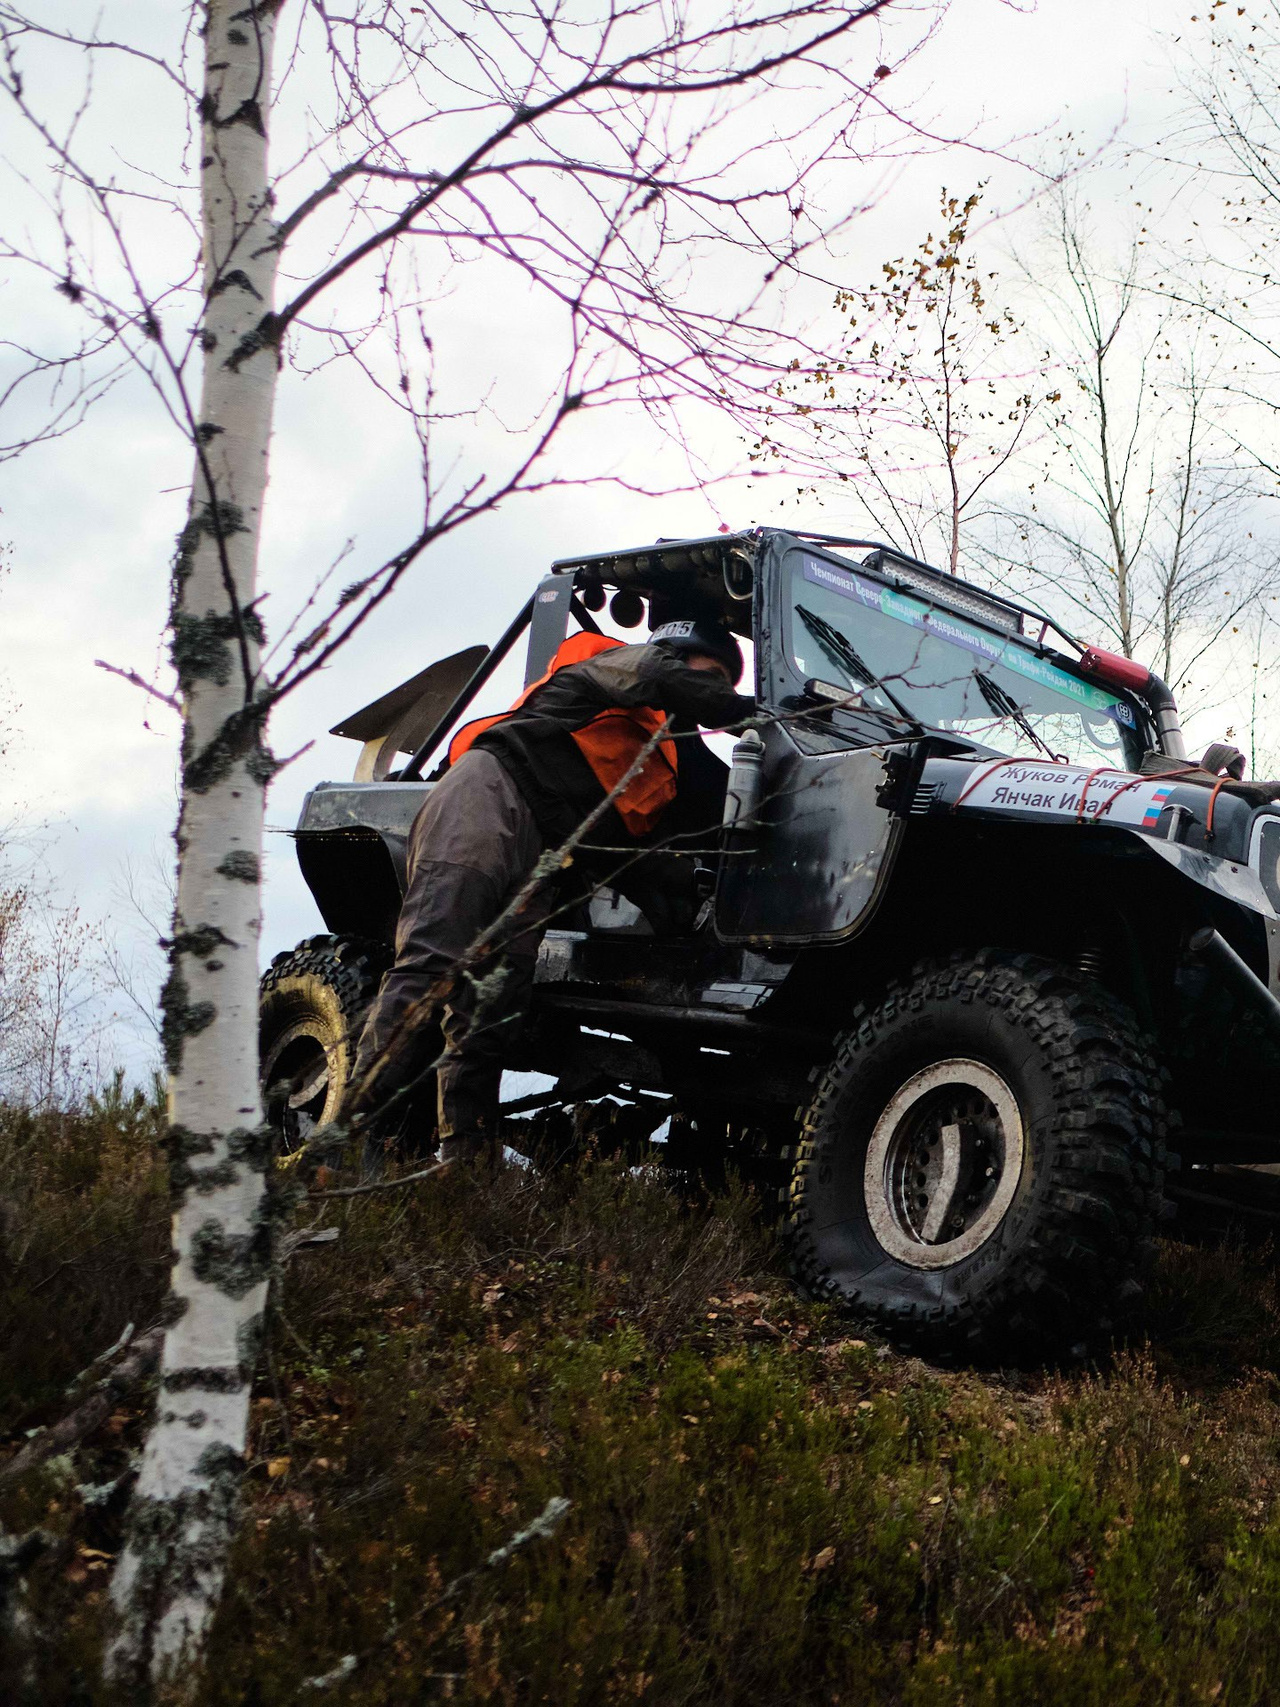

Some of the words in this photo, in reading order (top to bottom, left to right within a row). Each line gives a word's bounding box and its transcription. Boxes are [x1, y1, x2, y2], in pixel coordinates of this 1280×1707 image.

[655, 622, 691, 638] 205
[810, 561, 854, 592] Чемпионат
[1068, 679, 1086, 697] 2021
[1000, 766, 1069, 784] Жуков
[1072, 773, 1142, 793] Роман
[991, 787, 1055, 808] Янчак
[1058, 793, 1114, 815] Иван
